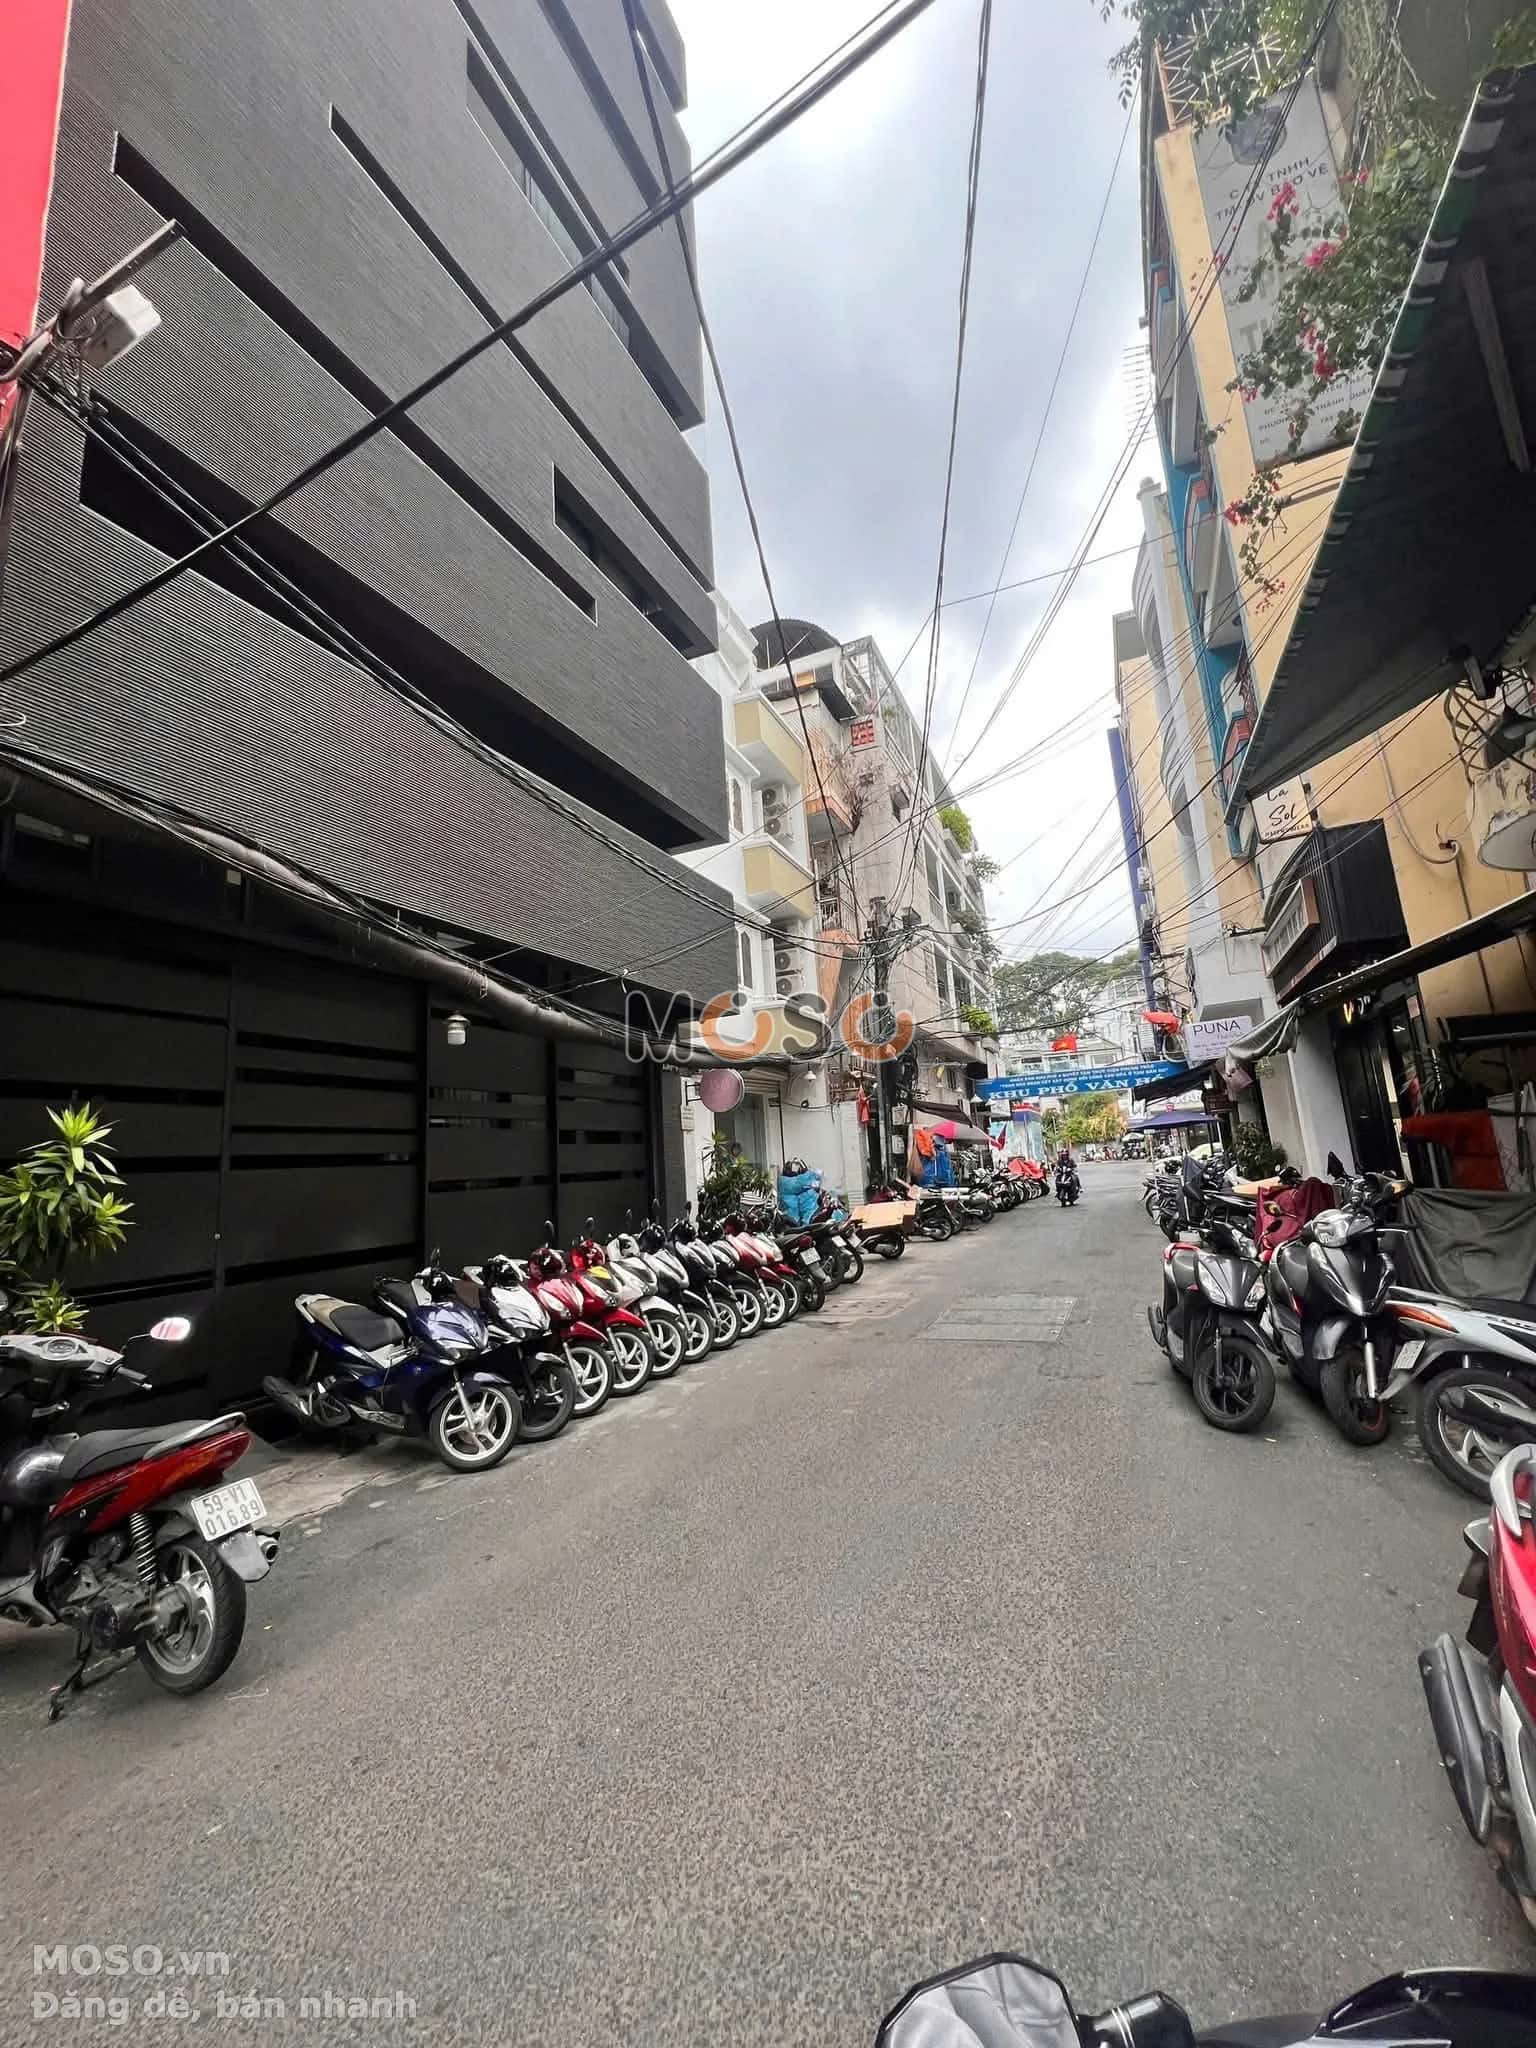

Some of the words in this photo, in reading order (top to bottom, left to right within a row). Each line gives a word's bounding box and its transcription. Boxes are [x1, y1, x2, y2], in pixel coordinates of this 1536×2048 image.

[1269, 803, 1297, 827] Sol
[1192, 1020, 1241, 1036] PUNA
[202, 1485, 247, 1515] 59-V1
